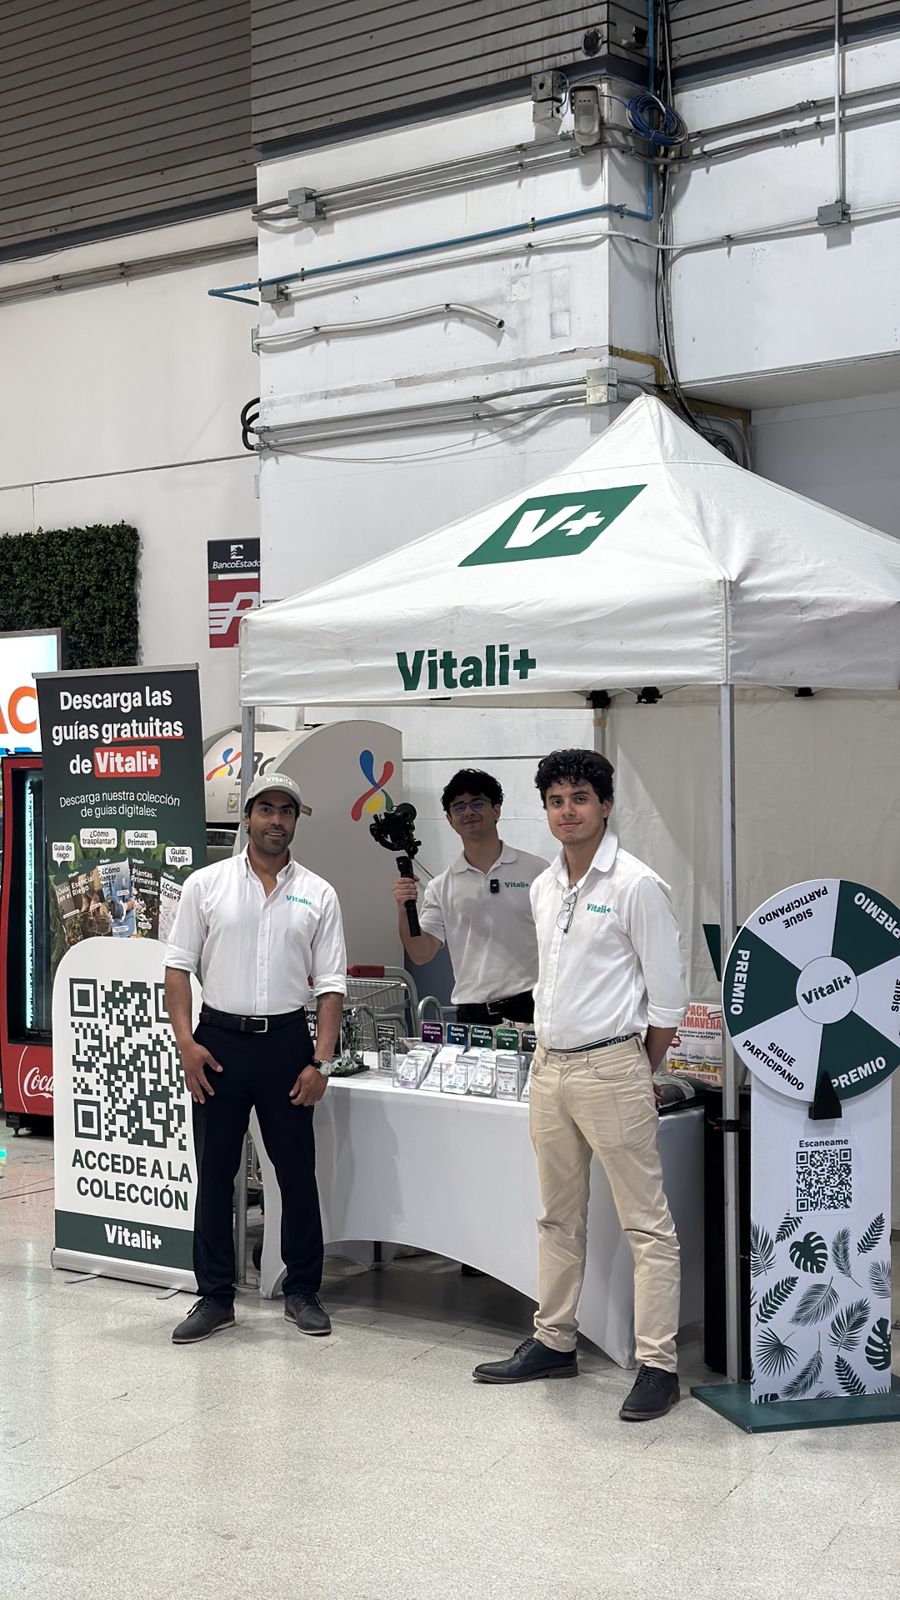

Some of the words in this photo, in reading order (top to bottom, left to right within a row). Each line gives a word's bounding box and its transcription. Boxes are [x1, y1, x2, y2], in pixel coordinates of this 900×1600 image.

[504, 504, 605, 549] V+
[396, 644, 537, 691] Vitali+
[60, 691, 142, 713] Descarga
[145, 686, 172, 706] las
[52, 721, 99, 746] guías
[102, 717, 183, 744] gratuitas
[70, 754, 92, 774] de
[95, 751, 158, 774] Vitali+
[60, 793, 100, 808] Descarga
[102, 791, 135, 801] nuestra
[136, 791, 180, 806] colección
[81, 807, 93, 818] de
[118, 804, 158, 818] digitales:
[56, 852, 70, 860] riego
[504, 881, 529, 889] Vitali+
[586, 903, 612, 914] Vitali+
[758, 886, 829, 925] PARTICIPANDO
[784, 908, 814, 929] SIGUE
[853, 891, 900, 939] PREMIO
[730, 949, 751, 1016] PREMIO
[801, 974, 852, 1005] Vitali+
[742, 1039, 805, 1091] PARTICIPANDO
[767, 1042, 796, 1067] SIGUE
[831, 1056, 887, 1089] PREMIO
[798, 1137, 849, 1149] Escaneame
[72, 1149, 147, 1177] ACCEDE
[150, 1159, 164, 1179] A
[167, 1161, 192, 1183] LA
[77, 1176, 188, 1211] COLECCIÓN
[104, 1223, 162, 1250] Vitali+
